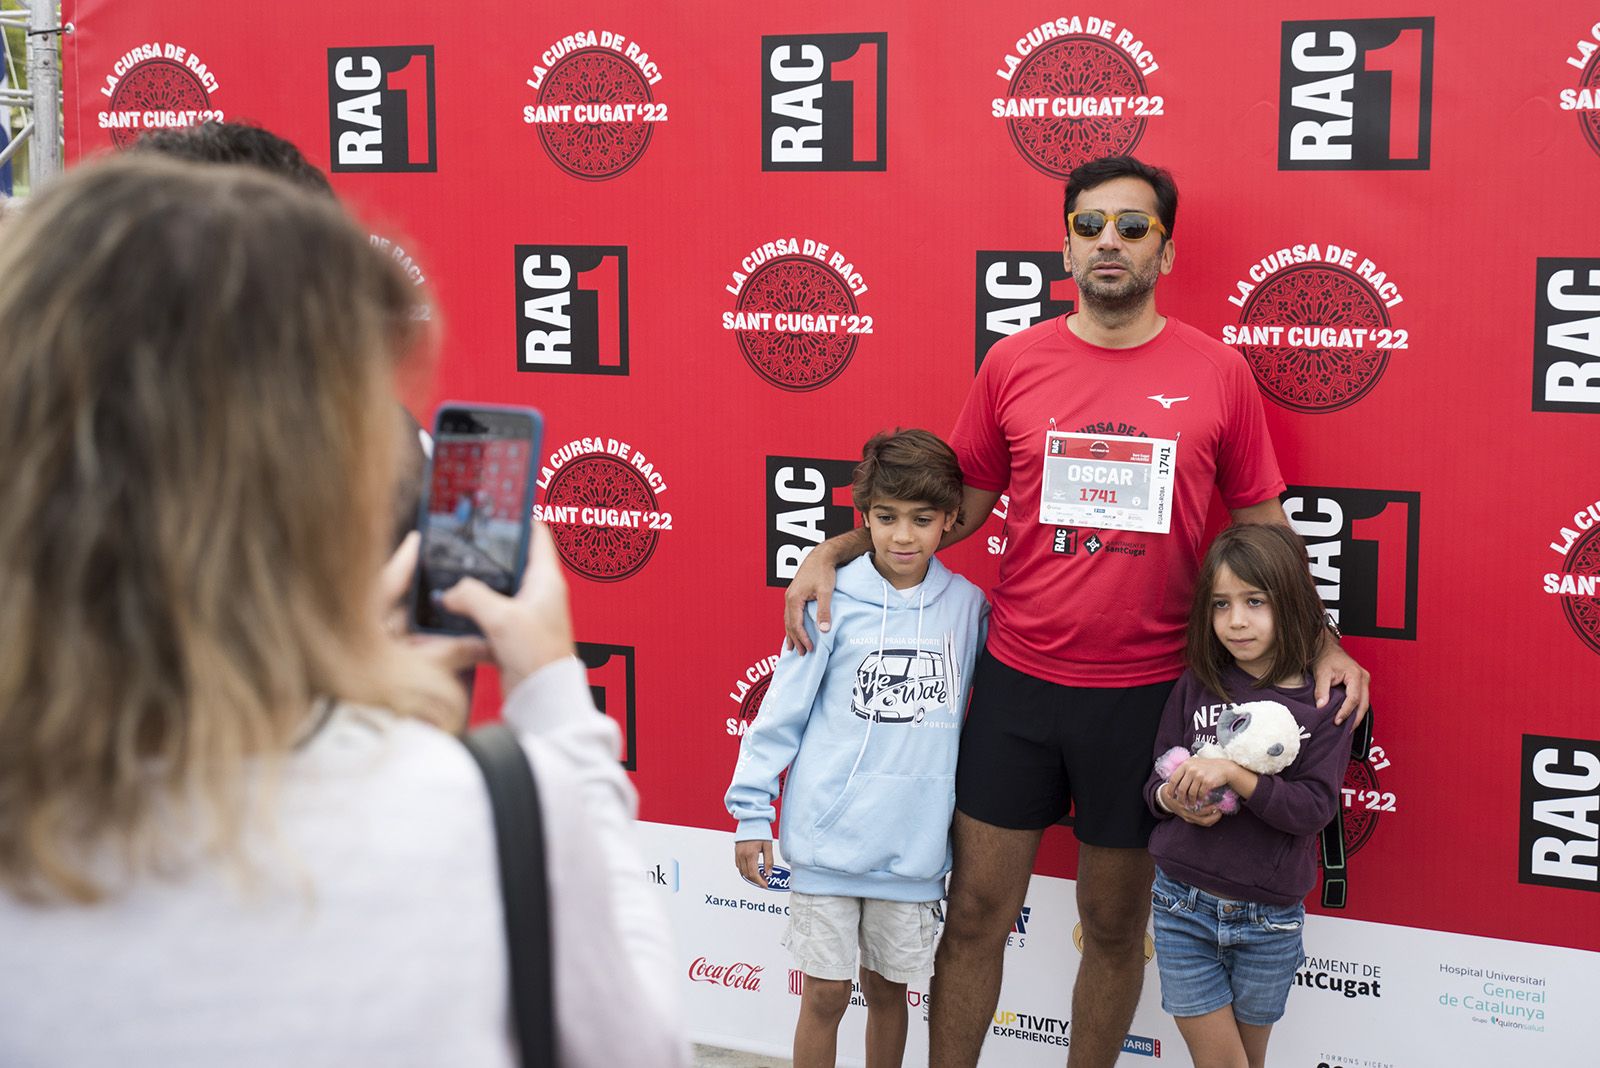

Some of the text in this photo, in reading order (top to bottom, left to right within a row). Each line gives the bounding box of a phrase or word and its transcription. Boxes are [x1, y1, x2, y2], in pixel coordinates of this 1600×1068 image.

[526, 30, 662, 90] LA CURSA DE RAC1
[996, 15, 1160, 82] LA CURSA DE RAC1
[1566, 39, 1599, 70] LA
[100, 42, 220, 98] LA CURSA DE RAC1
[769, 43, 824, 163] RAC
[991, 97, 1049, 118] SANT
[1051, 97, 1127, 118] CUGAT
[1289, 30, 1356, 161] RAC
[1560, 88, 1600, 110] SA
[98, 111, 141, 129] SANT
[142, 110, 198, 128] CUGAT
[335, 55, 383, 165] RAC
[523, 105, 571, 124] SANT
[573, 104, 636, 123] CUGAT
[725, 237, 869, 297] LA CURSA DE RAC1
[1227, 243, 1405, 309] LA CURSA DE RAC1
[522, 254, 572, 365] RAC
[985, 261, 1043, 337] AC
[722, 311, 772, 331] SANT
[774, 312, 839, 334] CUGAT
[1545, 269, 1600, 403] RAC
[1222, 325, 1285, 346] SANT
[1287, 327, 1368, 349] CUGAT
[1076, 422, 1114, 434] RSA
[1118, 423, 1137, 437] DE
[536, 436, 668, 495] LA CURSA DE RAC1
[1067, 464, 1134, 486] OSCAR
[1159, 447, 1171, 475] 1741
[992, 494, 1010, 520] LA
[1080, 488, 1117, 504] 1741
[532, 504, 579, 524] SANT
[582, 507, 641, 529] CUGAT
[775, 466, 826, 579] RAC
[1054, 529, 1067, 552] RAC
[1550, 527, 1580, 555] LA
[1282, 497, 1344, 624] AC
[746, 654, 780, 683] CUR
[729, 679, 751, 704] LA
[726, 718, 750, 736] SA
[1368, 737, 1391, 771] C1
[1531, 748, 1600, 881] RAC
[705, 894, 738, 909] Xarxa
[740, 899, 766, 912] Ford
[768, 903, 782, 915] de
[1303, 956, 1381, 979] TAMENT DE
[1439, 963, 1546, 986] Hospital Universitari
[1292, 970, 1381, 998] ntCugat
[1483, 982, 1545, 1004] General
[1439, 992, 1545, 1020] de Catalunya
[993, 1010, 1070, 1035] UPTIVITY
[993, 1026, 1070, 1047] EXPERIENCES
[1124, 1039, 1153, 1053] TARIS
